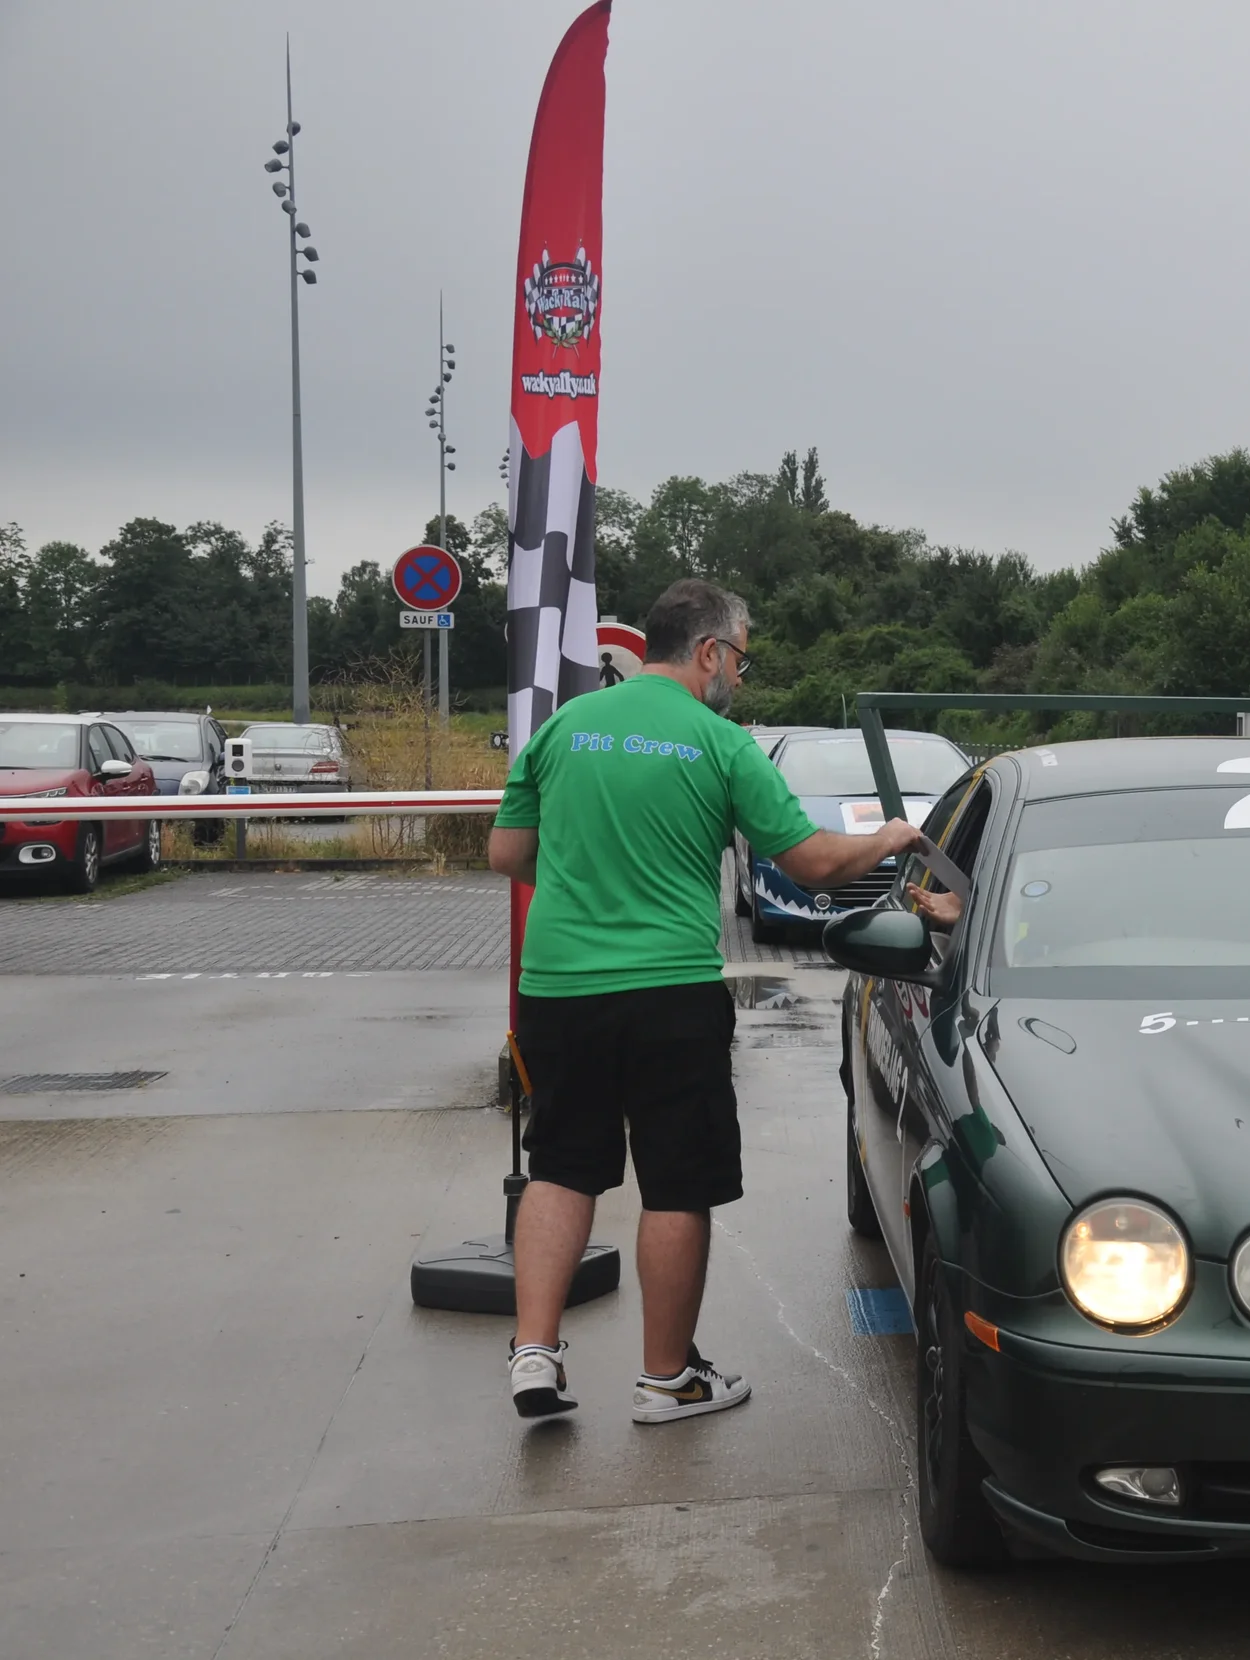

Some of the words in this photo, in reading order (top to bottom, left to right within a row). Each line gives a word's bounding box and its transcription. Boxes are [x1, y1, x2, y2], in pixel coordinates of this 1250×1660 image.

[404, 615, 434, 625] SAUF
[571, 732, 614, 751] Pit
[623, 735, 702, 762] Crew
[1139, 1012, 1177, 1034] 5
